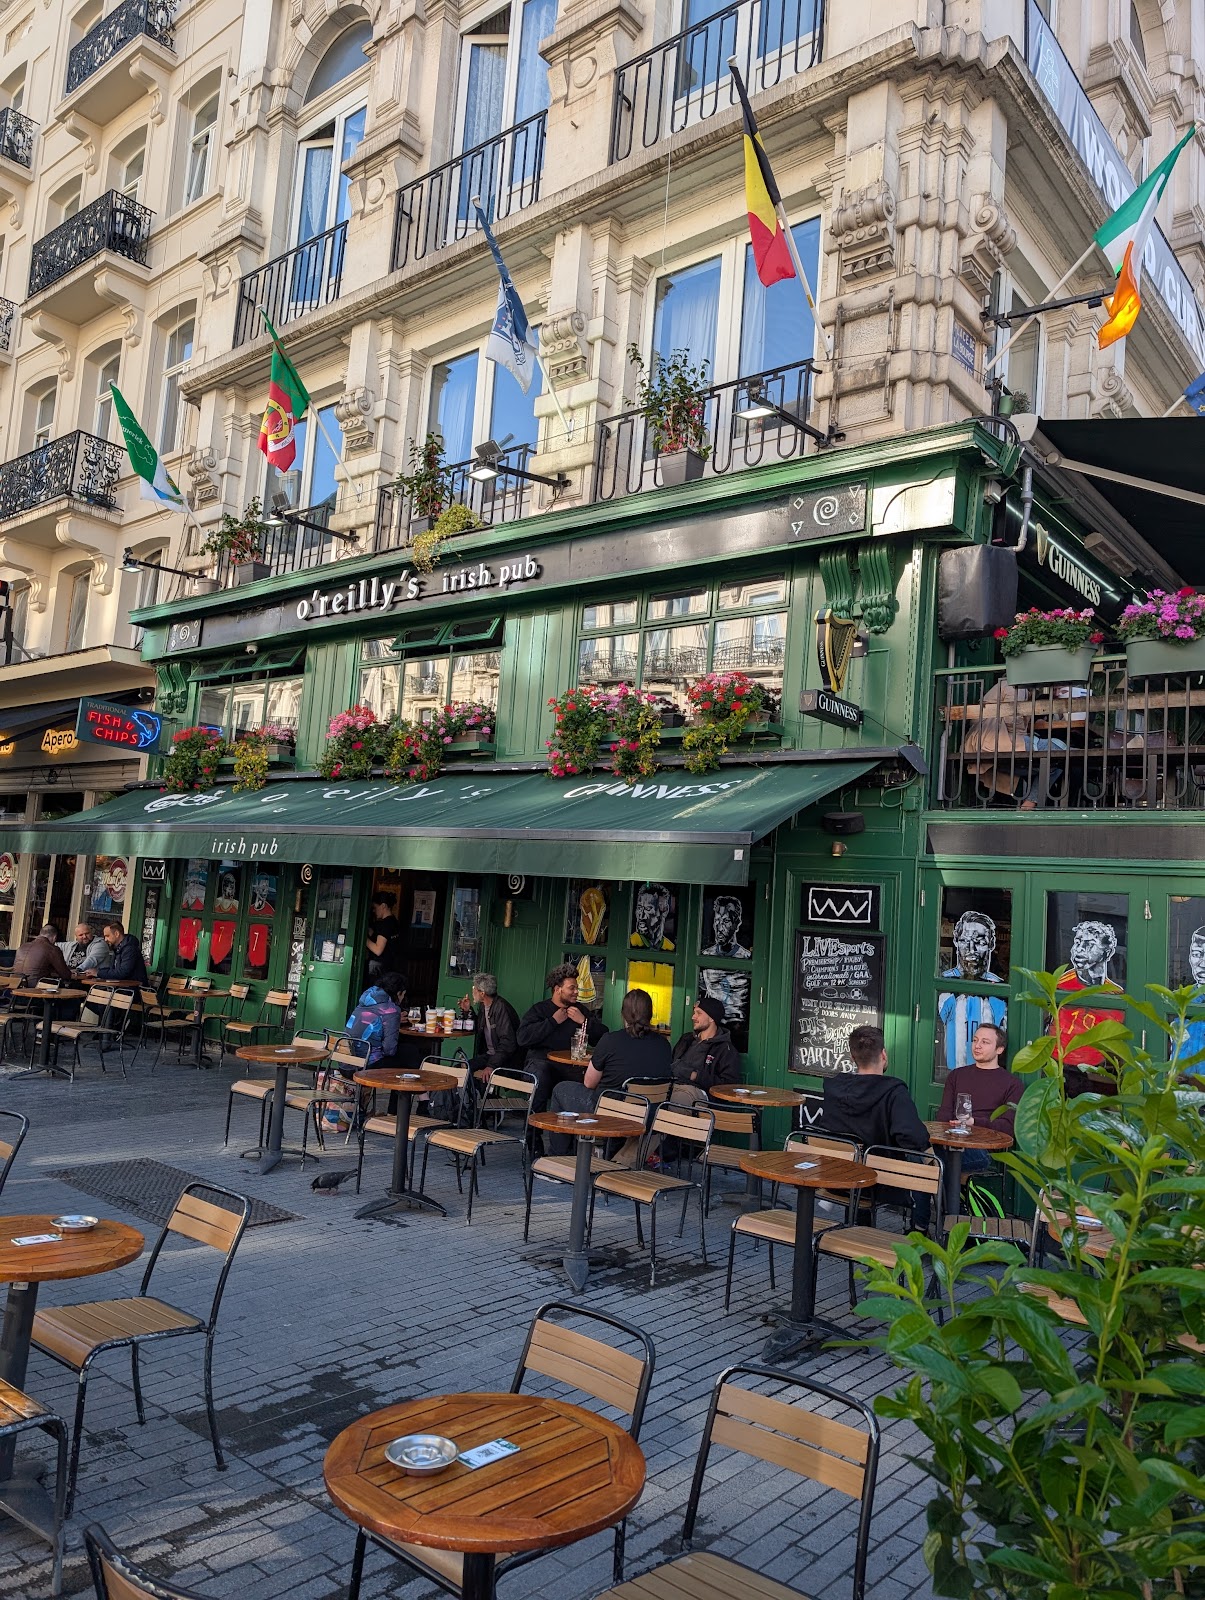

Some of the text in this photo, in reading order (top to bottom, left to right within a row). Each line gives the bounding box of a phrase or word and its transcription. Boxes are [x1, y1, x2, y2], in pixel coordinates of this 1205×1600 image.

[1083, 114, 1196, 341] WOD CUP
[121, 424, 143, 445] imerick
[1048, 545, 1101, 606] GUINNESS
[296, 554, 538, 621] o'reilly's irish pub
[86, 701, 128, 716] TRADITIONAL
[818, 694, 859, 722] GUINNESS
[88, 711, 122, 728] FISH
[94, 727, 138, 745] CHIPS
[211, 837, 278, 858] irish pub
[802, 936, 839, 957] LIVE
[801, 998, 818, 1008] VISIT
[819, 1000, 833, 1010] OUR
[861, 1005, 877, 1015] BAR
[821, 1010, 839, 1018] DOORS
[840, 1012, 857, 1021] AWAY
[799, 1046, 857, 1074] PARTY BA
